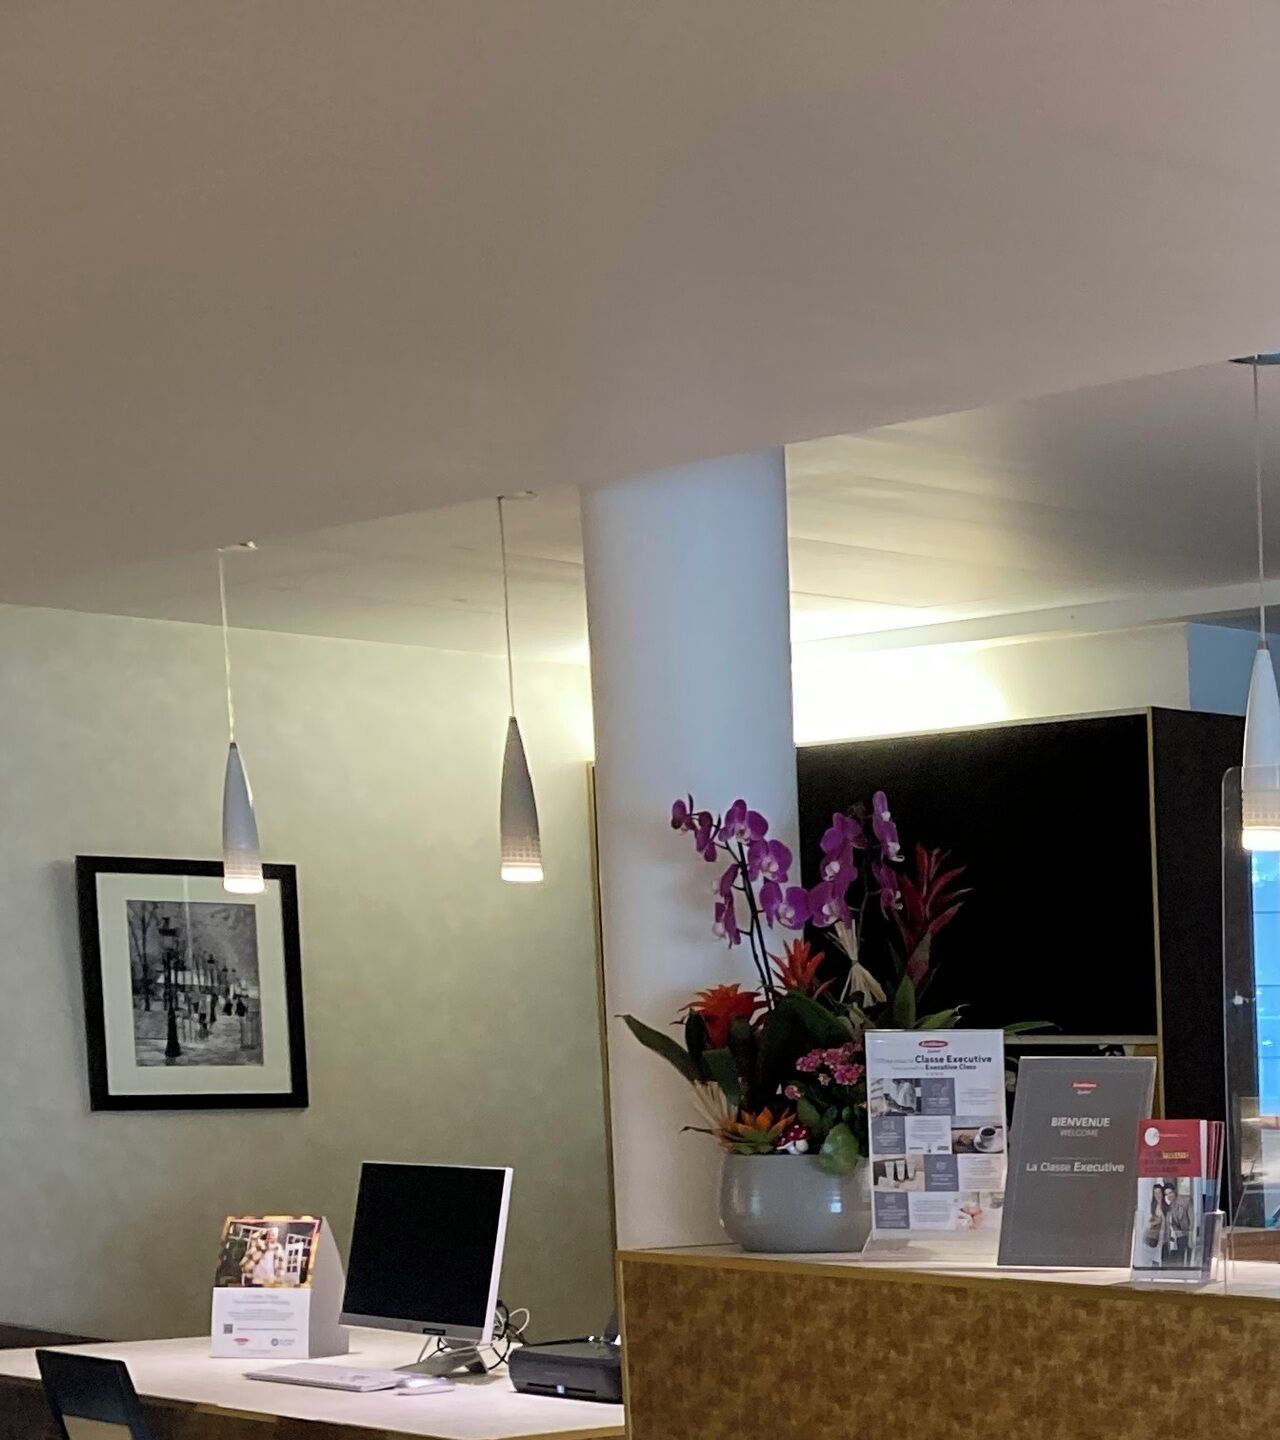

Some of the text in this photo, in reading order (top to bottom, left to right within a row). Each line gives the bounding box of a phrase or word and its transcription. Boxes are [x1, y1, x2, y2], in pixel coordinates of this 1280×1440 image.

[914, 1055, 944, 1063] Classe
[946, 1054, 992, 1063] Executive
[1051, 1117, 1111, 1127] BIENVENUE
[1059, 1129, 1099, 1137] WELCOME
[1026, 1162, 1125, 1172] La Classe Executive
